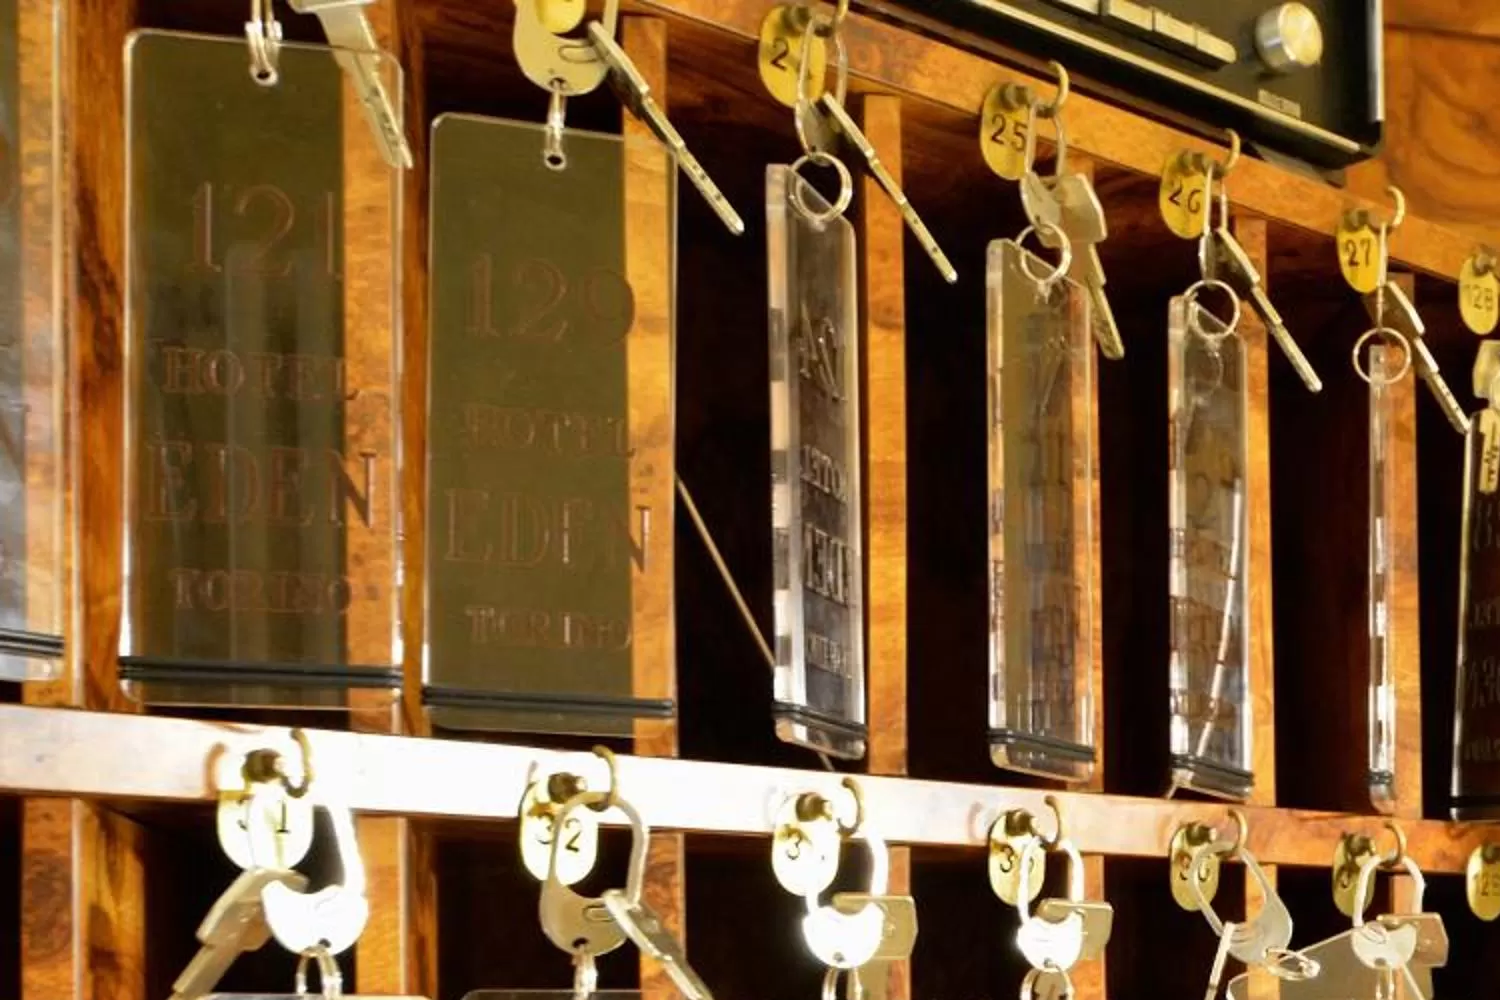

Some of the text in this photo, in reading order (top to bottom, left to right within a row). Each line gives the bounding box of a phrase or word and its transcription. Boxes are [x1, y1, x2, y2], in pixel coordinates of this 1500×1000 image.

[991, 113, 1029, 152] 25
[1168, 179, 1204, 214] 26
[1345, 238, 1373, 268] 27
[161, 345, 360, 401] HOTEL
[145, 438, 377, 528] EDEN
[444, 488, 651, 574] EDEN
[535, 813, 582, 852] 32
